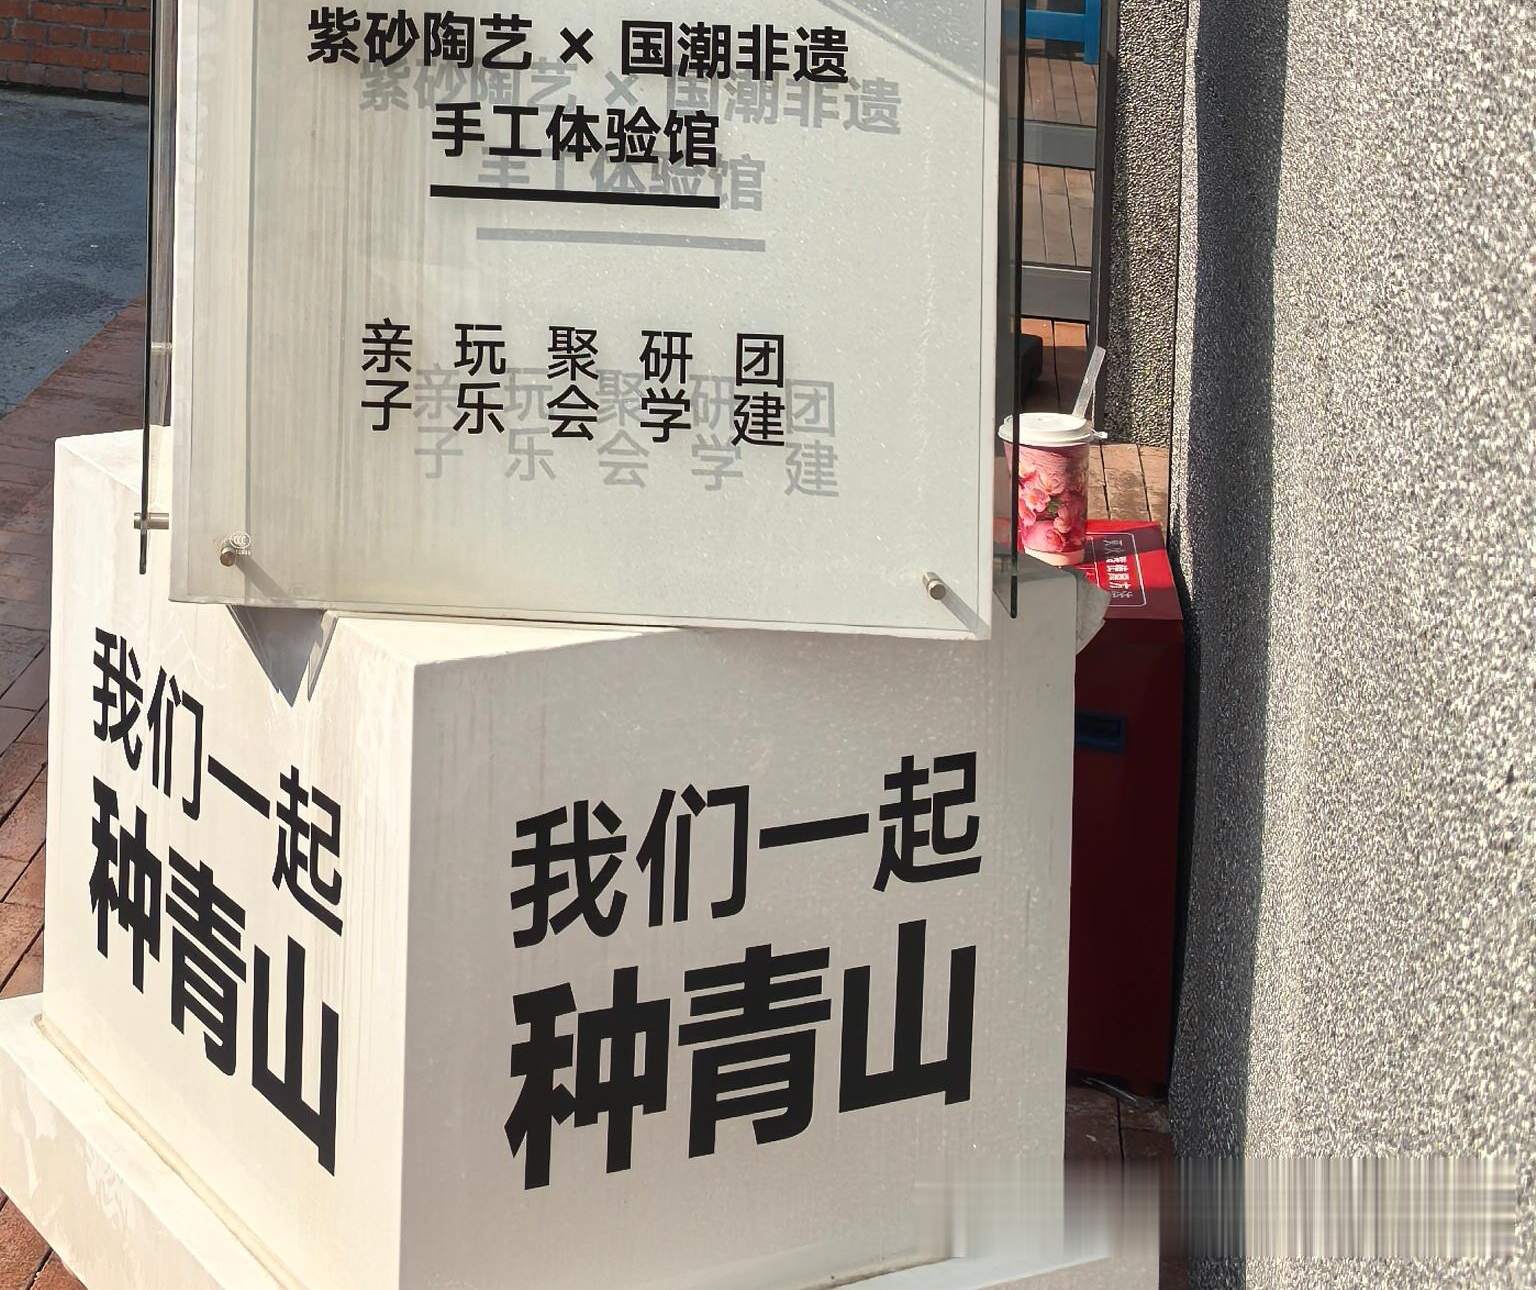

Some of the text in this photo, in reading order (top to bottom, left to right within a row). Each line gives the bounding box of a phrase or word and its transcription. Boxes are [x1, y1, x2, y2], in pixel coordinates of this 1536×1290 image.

[307, 6, 533, 70] 紫砂陶艺
[621, 19, 849, 84] 国潮非遗
[431, 101, 720, 168] 手工体验馆
[92, 626, 344, 935] 我们一起
[511, 750, 982, 948] 我们一起
[90, 776, 340, 1178] 种青山
[503, 918, 976, 1191] 种青山
